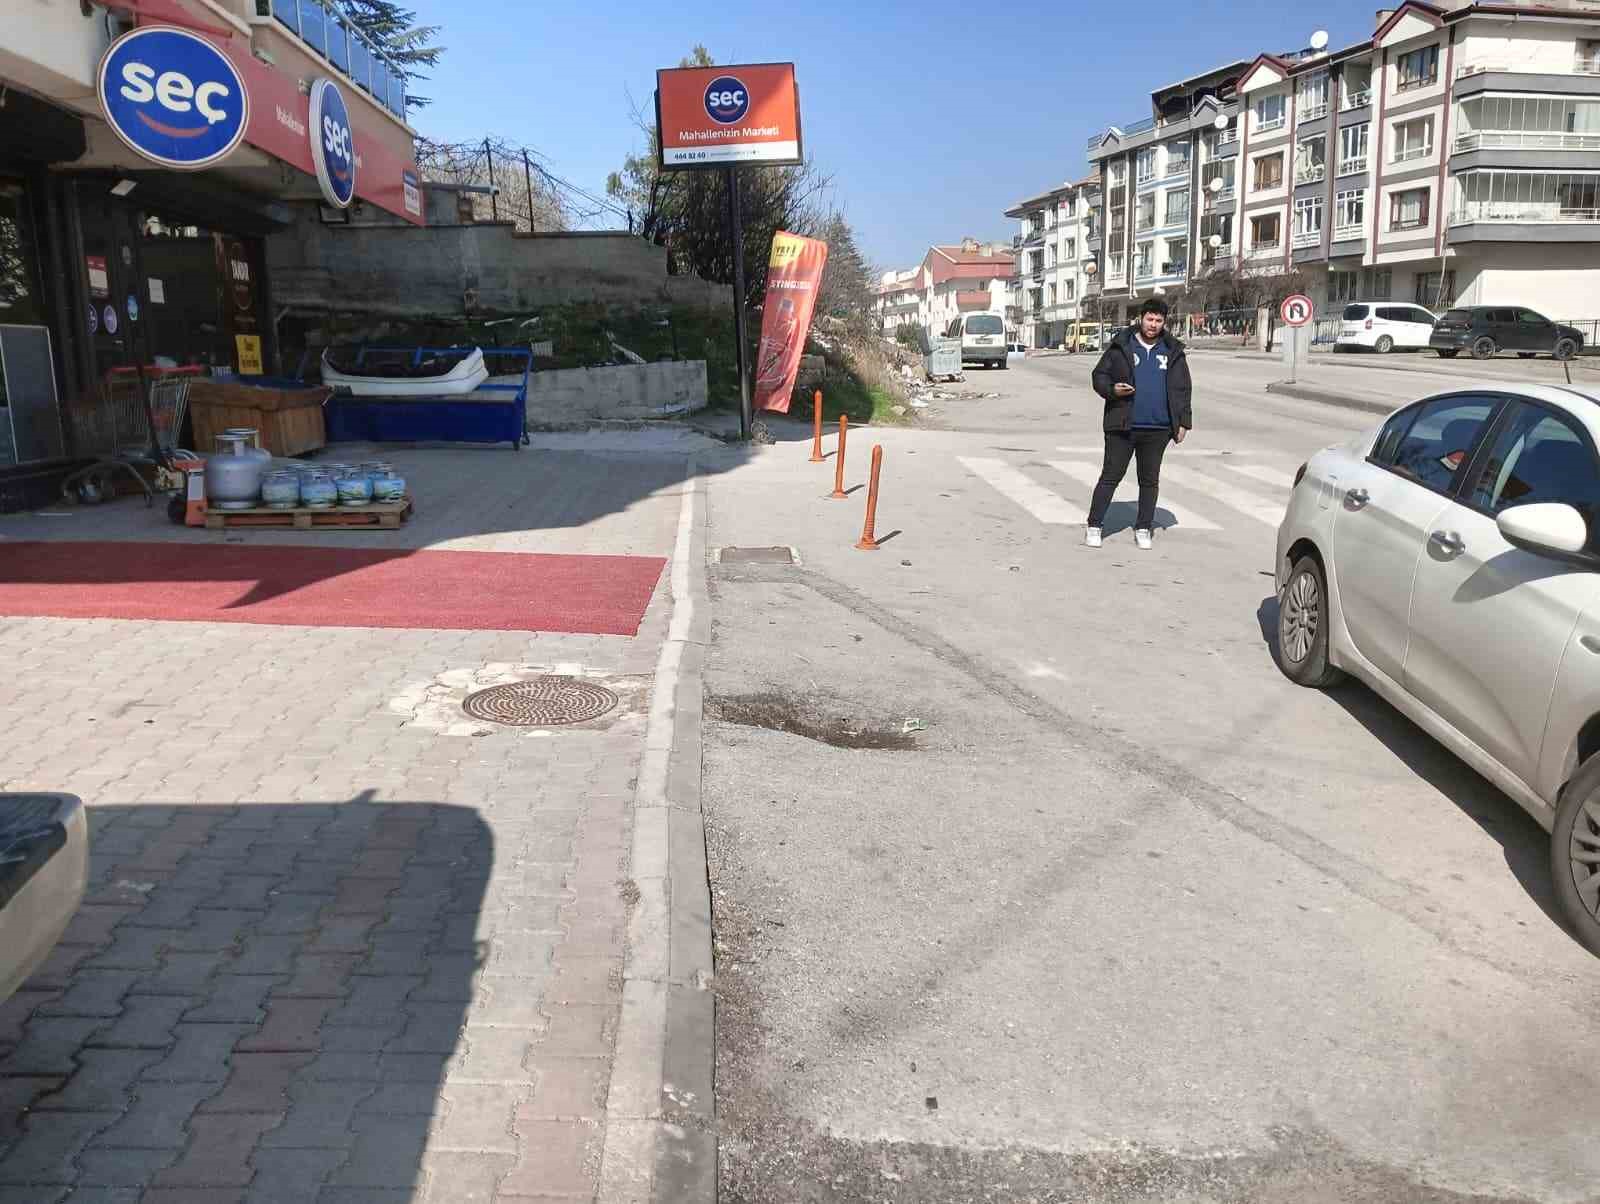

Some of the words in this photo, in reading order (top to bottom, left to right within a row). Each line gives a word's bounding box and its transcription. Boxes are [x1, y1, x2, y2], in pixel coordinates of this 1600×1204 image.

[120, 62, 229, 125] seç
[709, 90, 745, 107] seç
[324, 115, 351, 165] seç
[679, 128, 740, 141] Mahallenizin
[742, 126, 780, 137] Marketi
